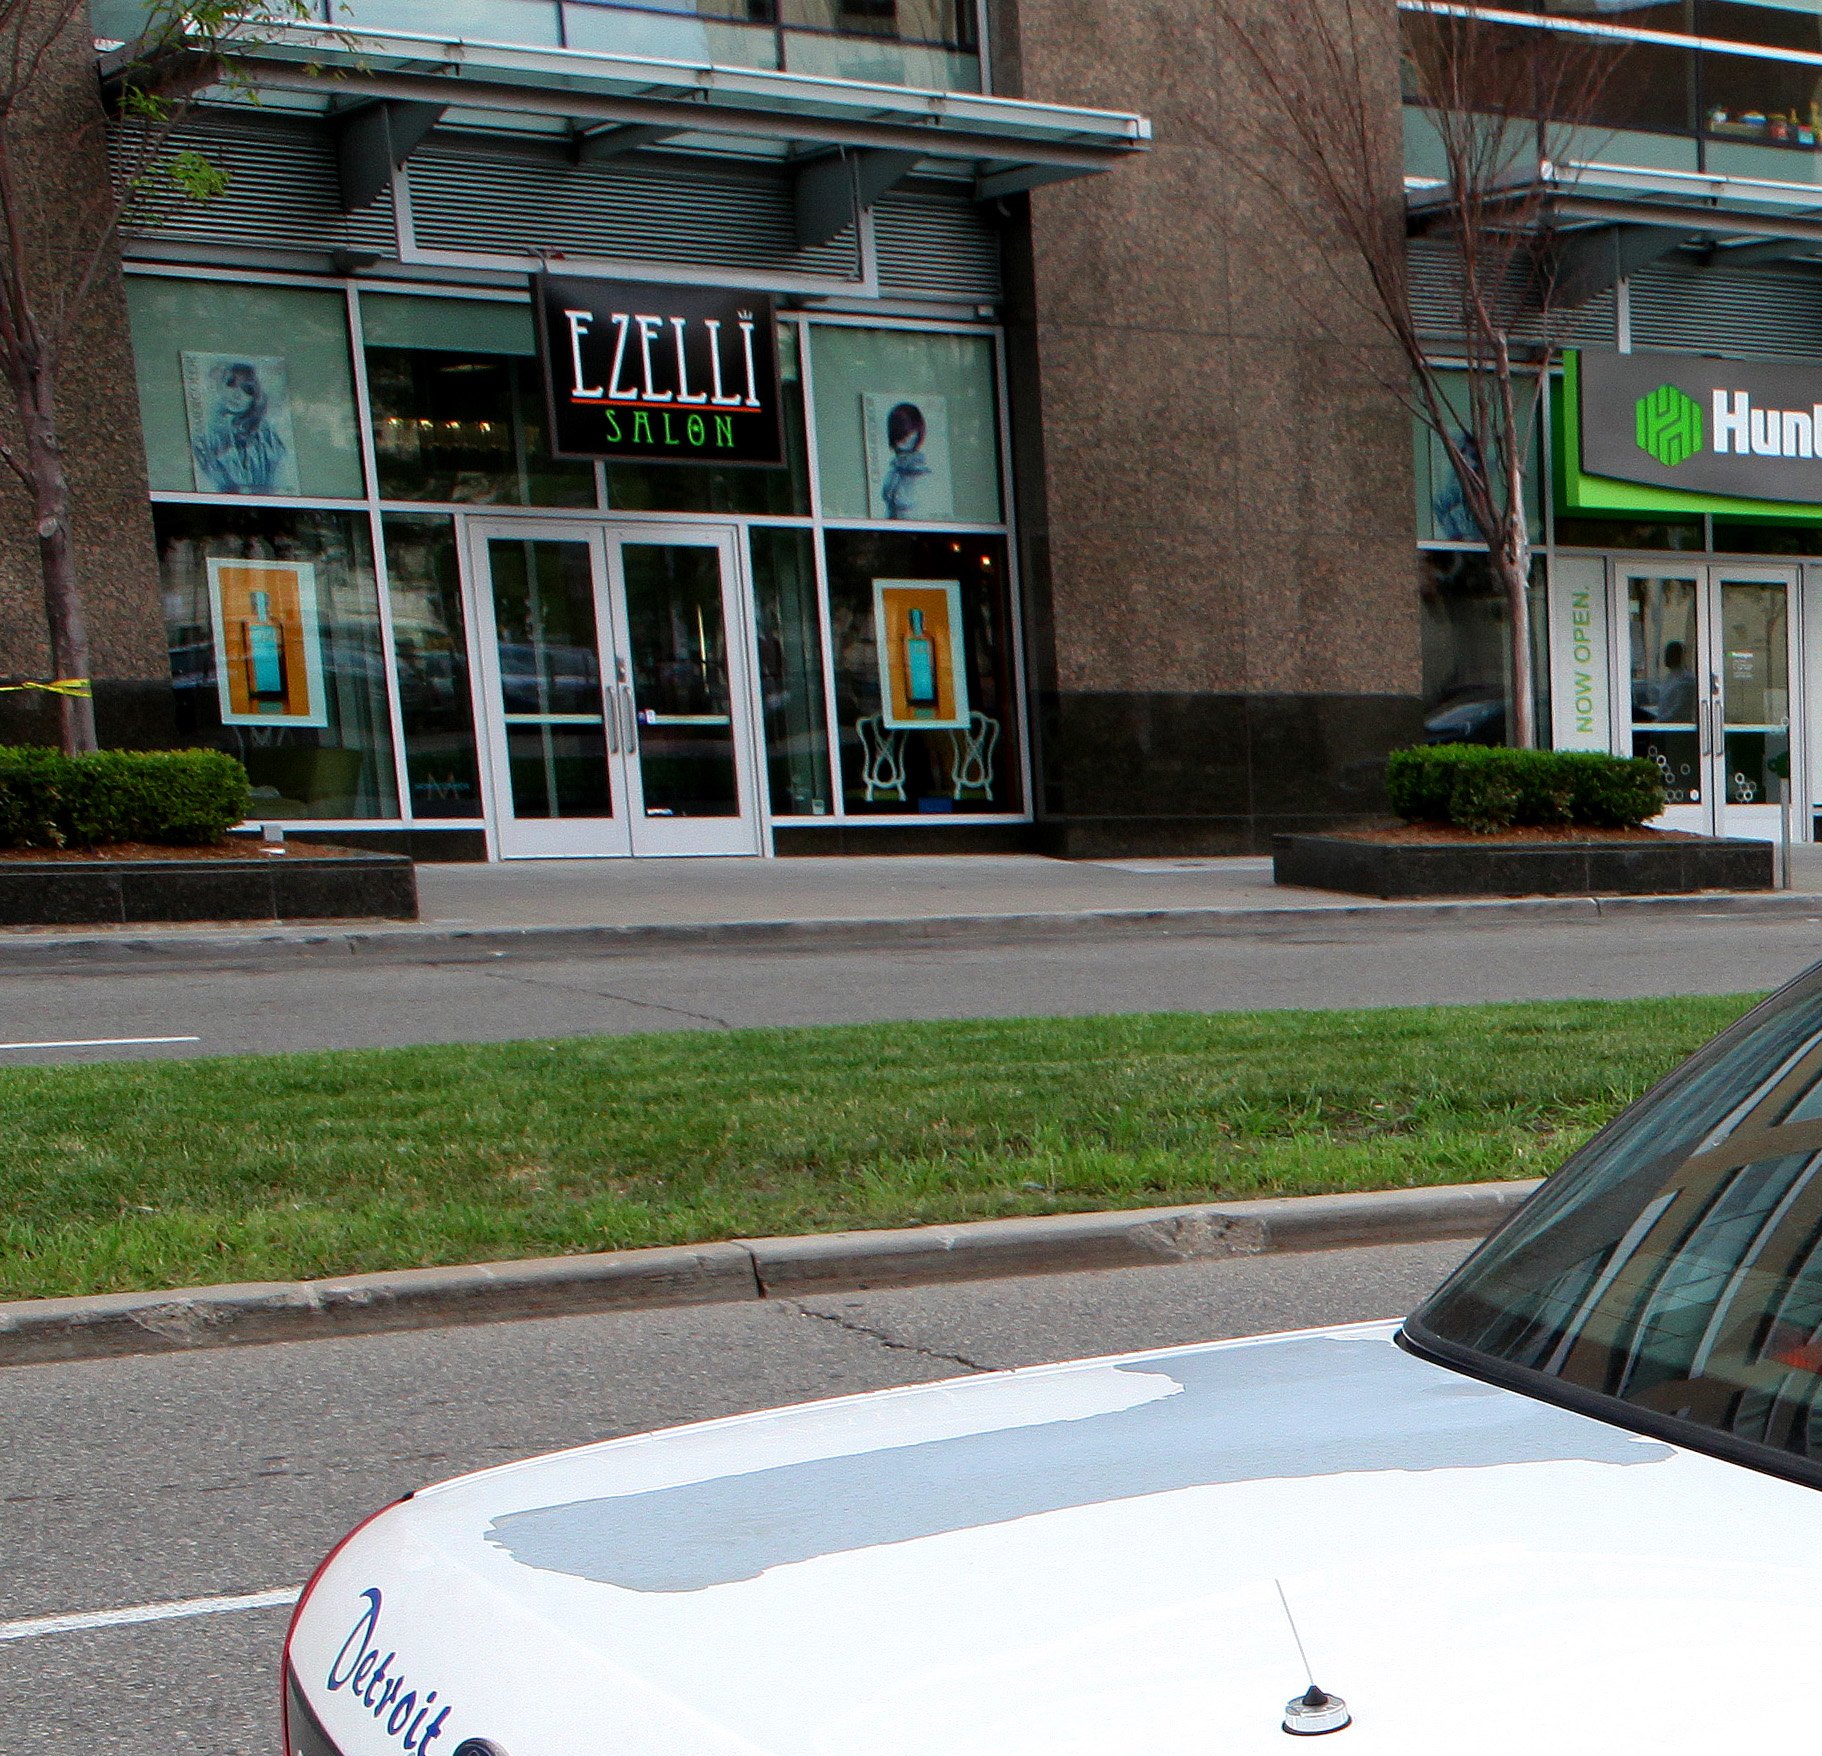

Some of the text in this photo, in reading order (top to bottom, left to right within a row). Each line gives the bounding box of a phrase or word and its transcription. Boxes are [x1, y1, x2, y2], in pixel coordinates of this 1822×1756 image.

[564, 309, 761, 408] EZELLI
[605, 409, 735, 449] SALON
[1572, 586, 1594, 734] NOW OPEN.
